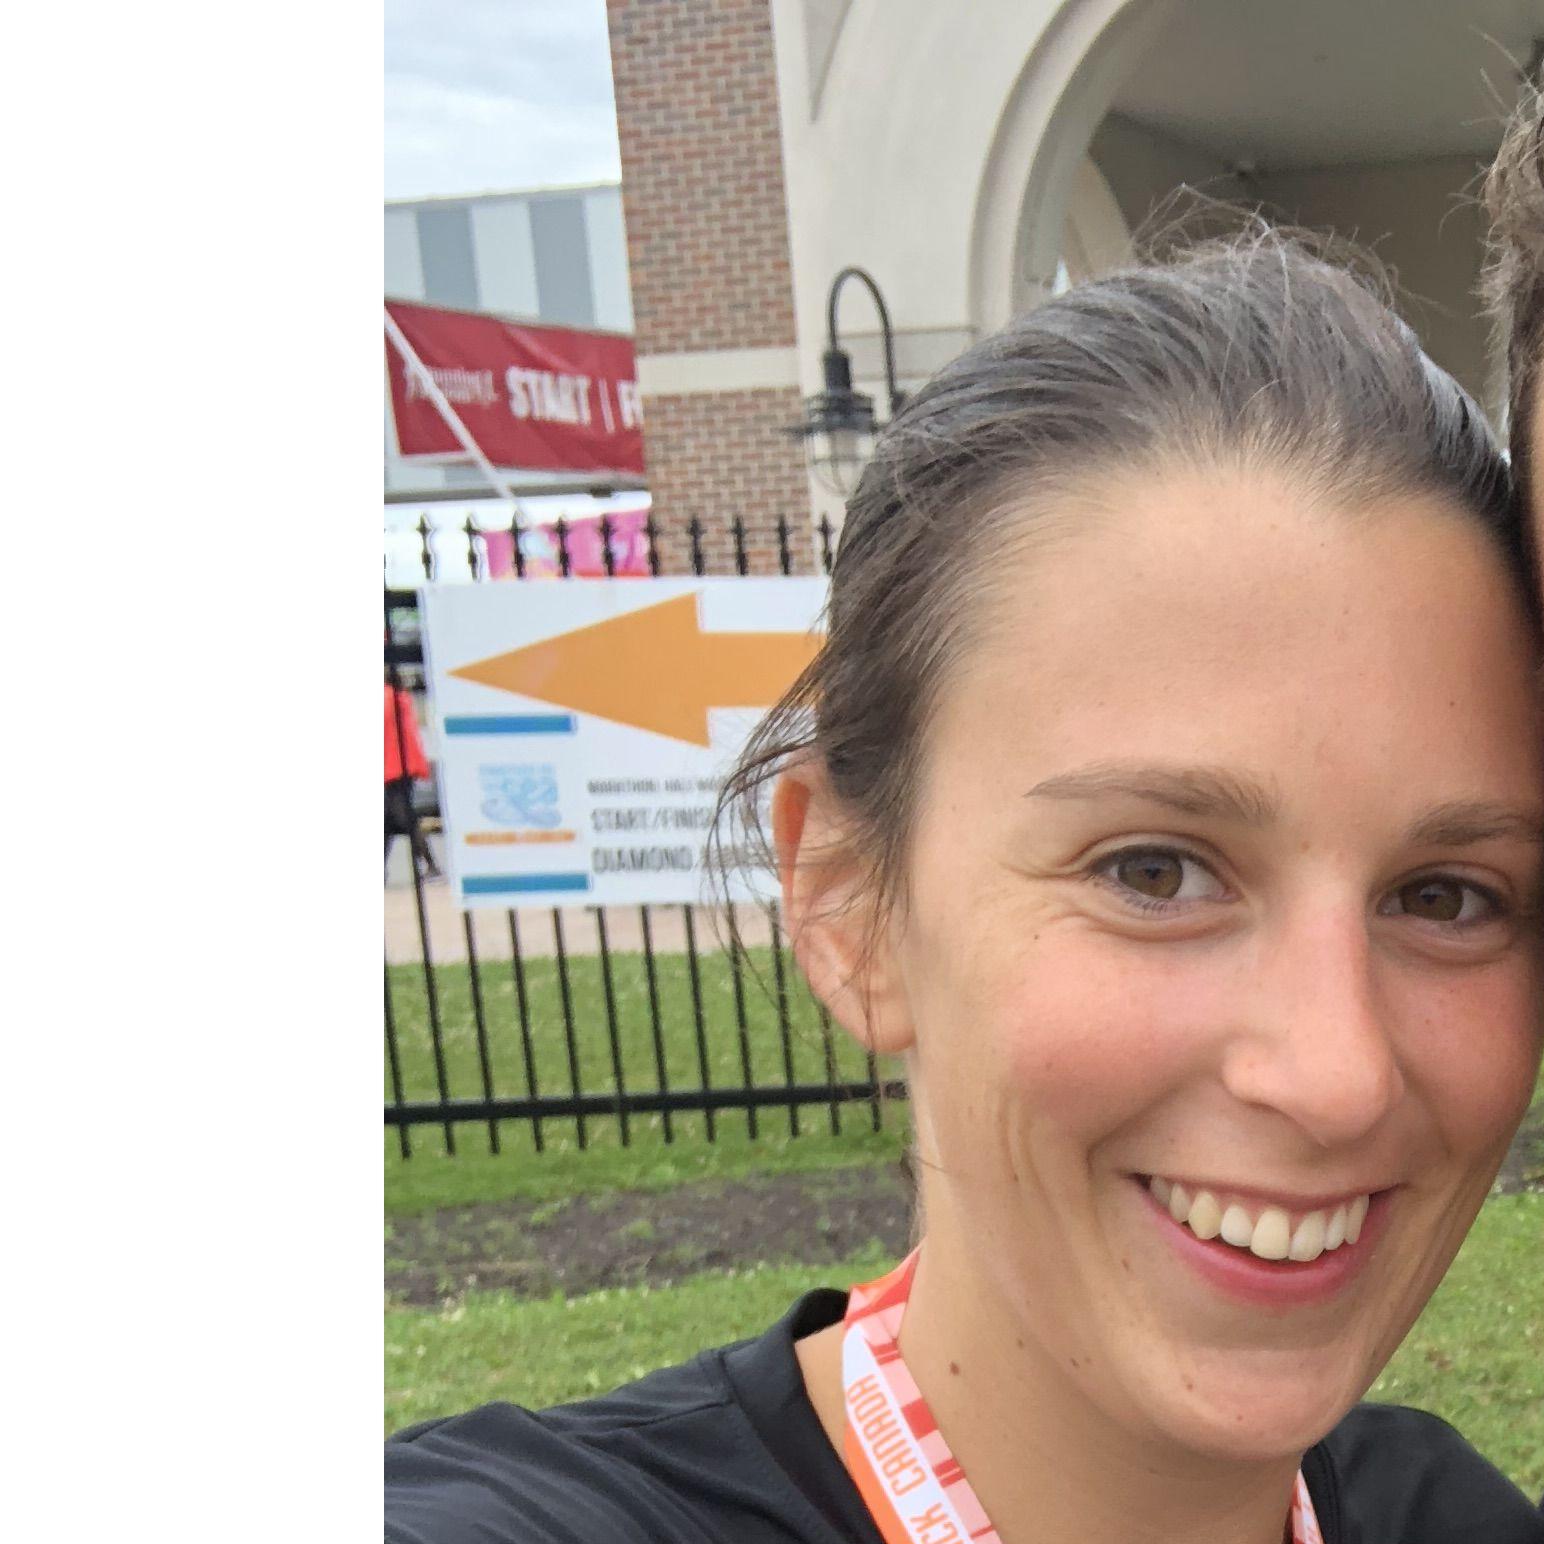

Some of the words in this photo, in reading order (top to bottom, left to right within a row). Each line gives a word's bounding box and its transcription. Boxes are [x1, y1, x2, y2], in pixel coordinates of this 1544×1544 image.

[505, 366, 592, 425] START
[592, 846, 694, 874] DIAMOND
[847, 1373, 927, 1496] CANADA
